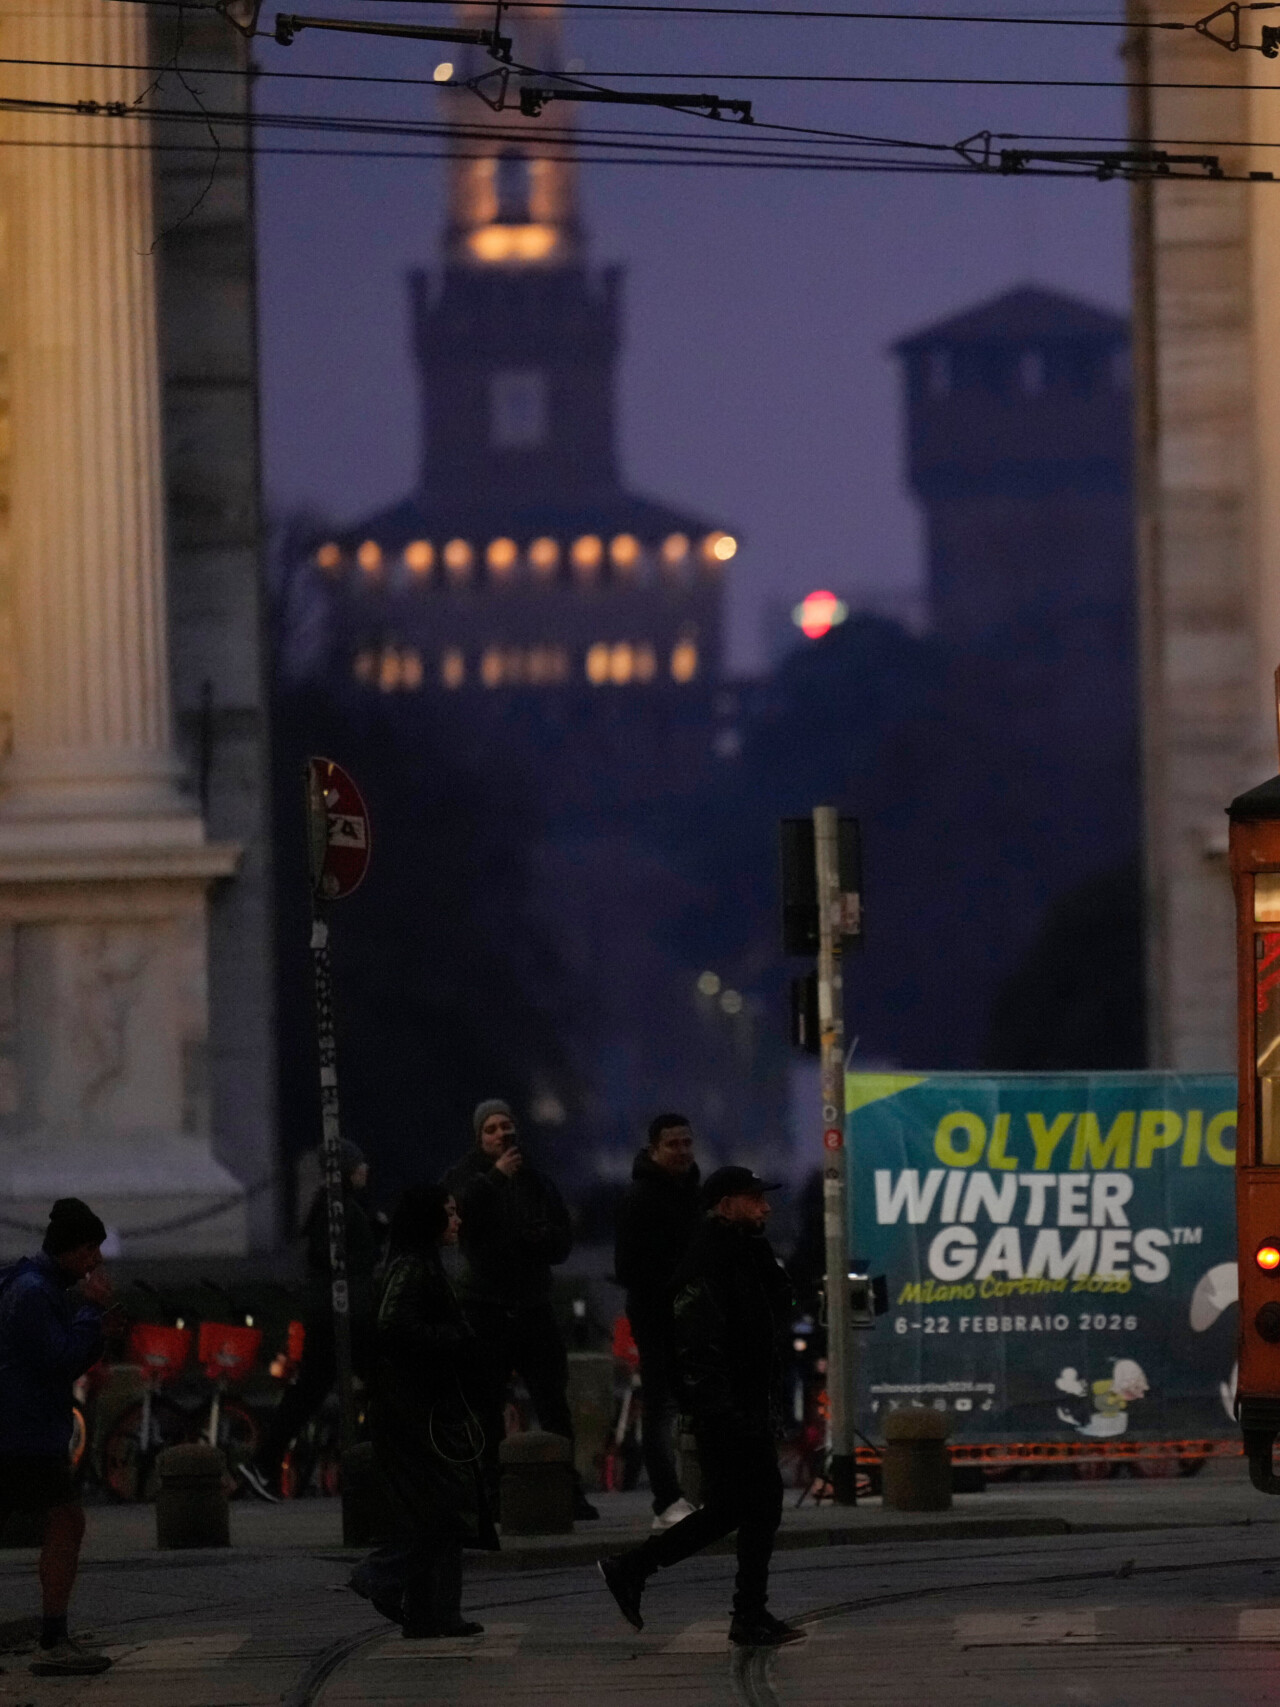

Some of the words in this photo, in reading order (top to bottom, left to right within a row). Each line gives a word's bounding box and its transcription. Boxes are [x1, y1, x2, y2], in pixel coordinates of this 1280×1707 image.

[934, 1110, 1238, 1170] OLYMPIC
[874, 1169, 1135, 1227] WINTER
[897, 1279, 976, 1305] Milano
[979, 1273, 1068, 1299] Cortina
[1071, 1271, 1133, 1294] 2026
[894, 1316, 950, 1335] 6-22
[958, 1314, 1070, 1333] FEBBRAIO
[1078, 1313, 1139, 1332] 2026
